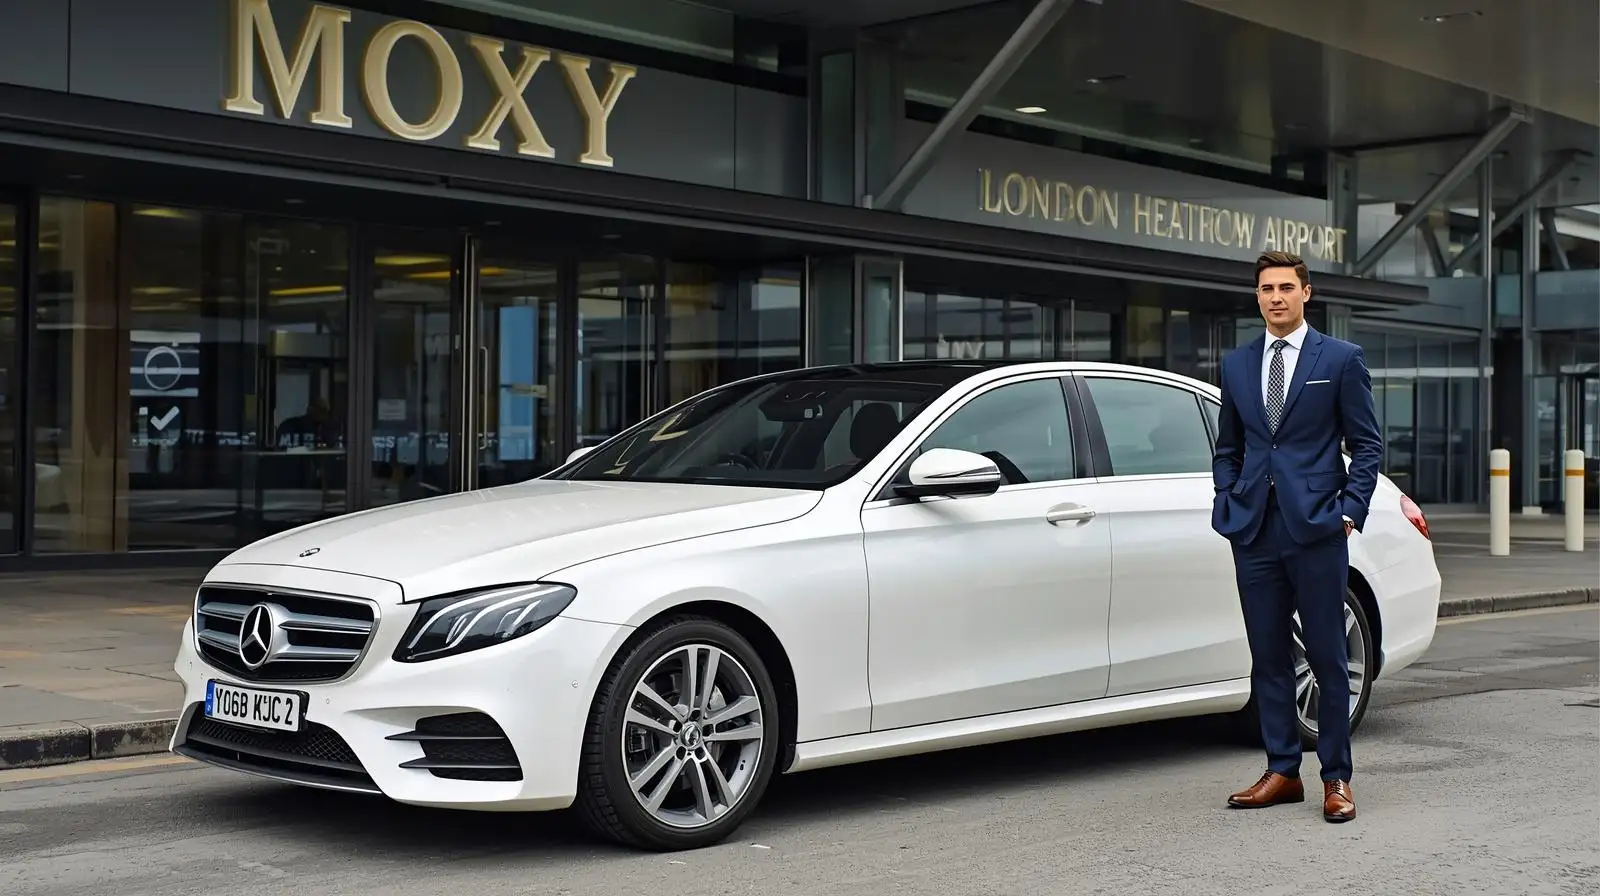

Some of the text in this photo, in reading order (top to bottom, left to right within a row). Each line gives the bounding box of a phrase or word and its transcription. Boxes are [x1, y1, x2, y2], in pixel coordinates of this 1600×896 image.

[222, 0, 637, 168] MOXY
[980, 168, 1119, 230] LONDON
[1263, 215, 1347, 263] AIRPORT
